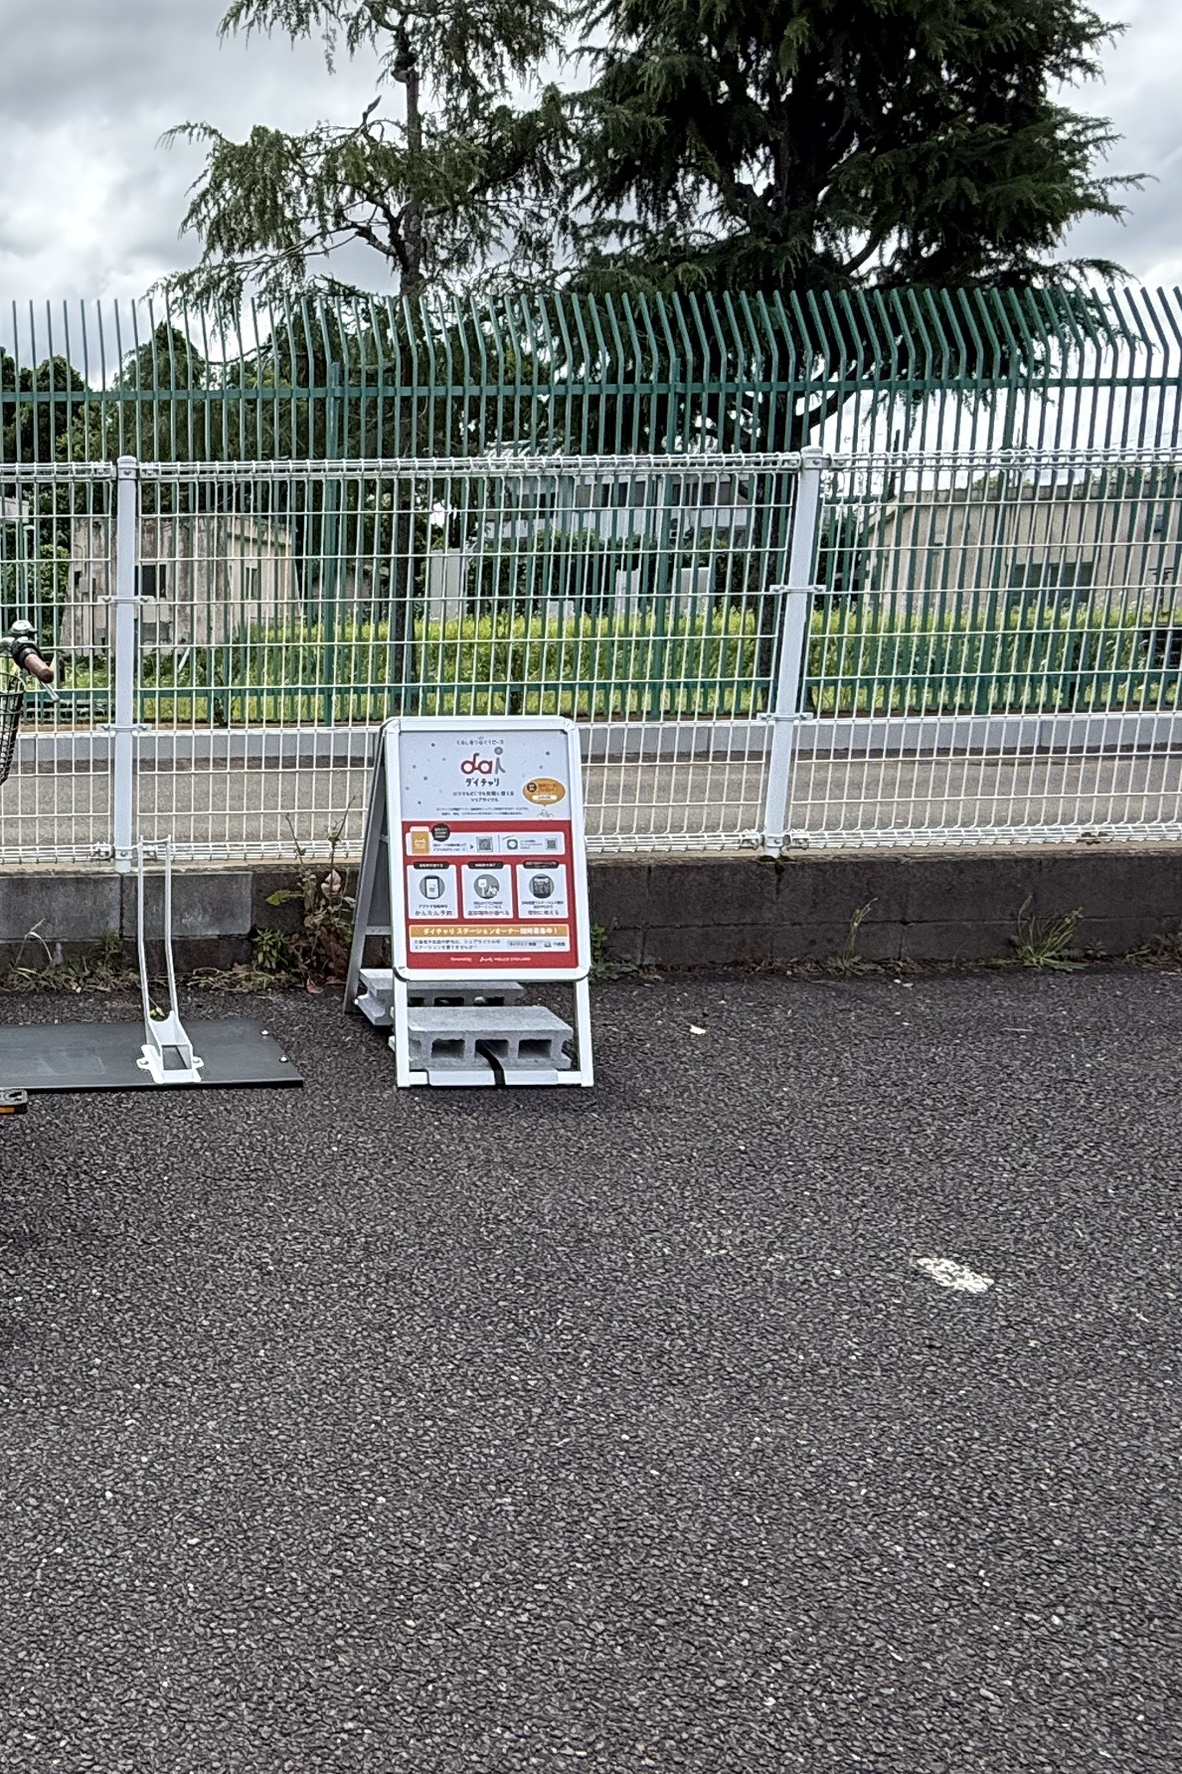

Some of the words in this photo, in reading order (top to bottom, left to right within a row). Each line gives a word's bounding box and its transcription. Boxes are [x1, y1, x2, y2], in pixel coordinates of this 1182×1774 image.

[465, 777, 500, 787] ダイチャリ
